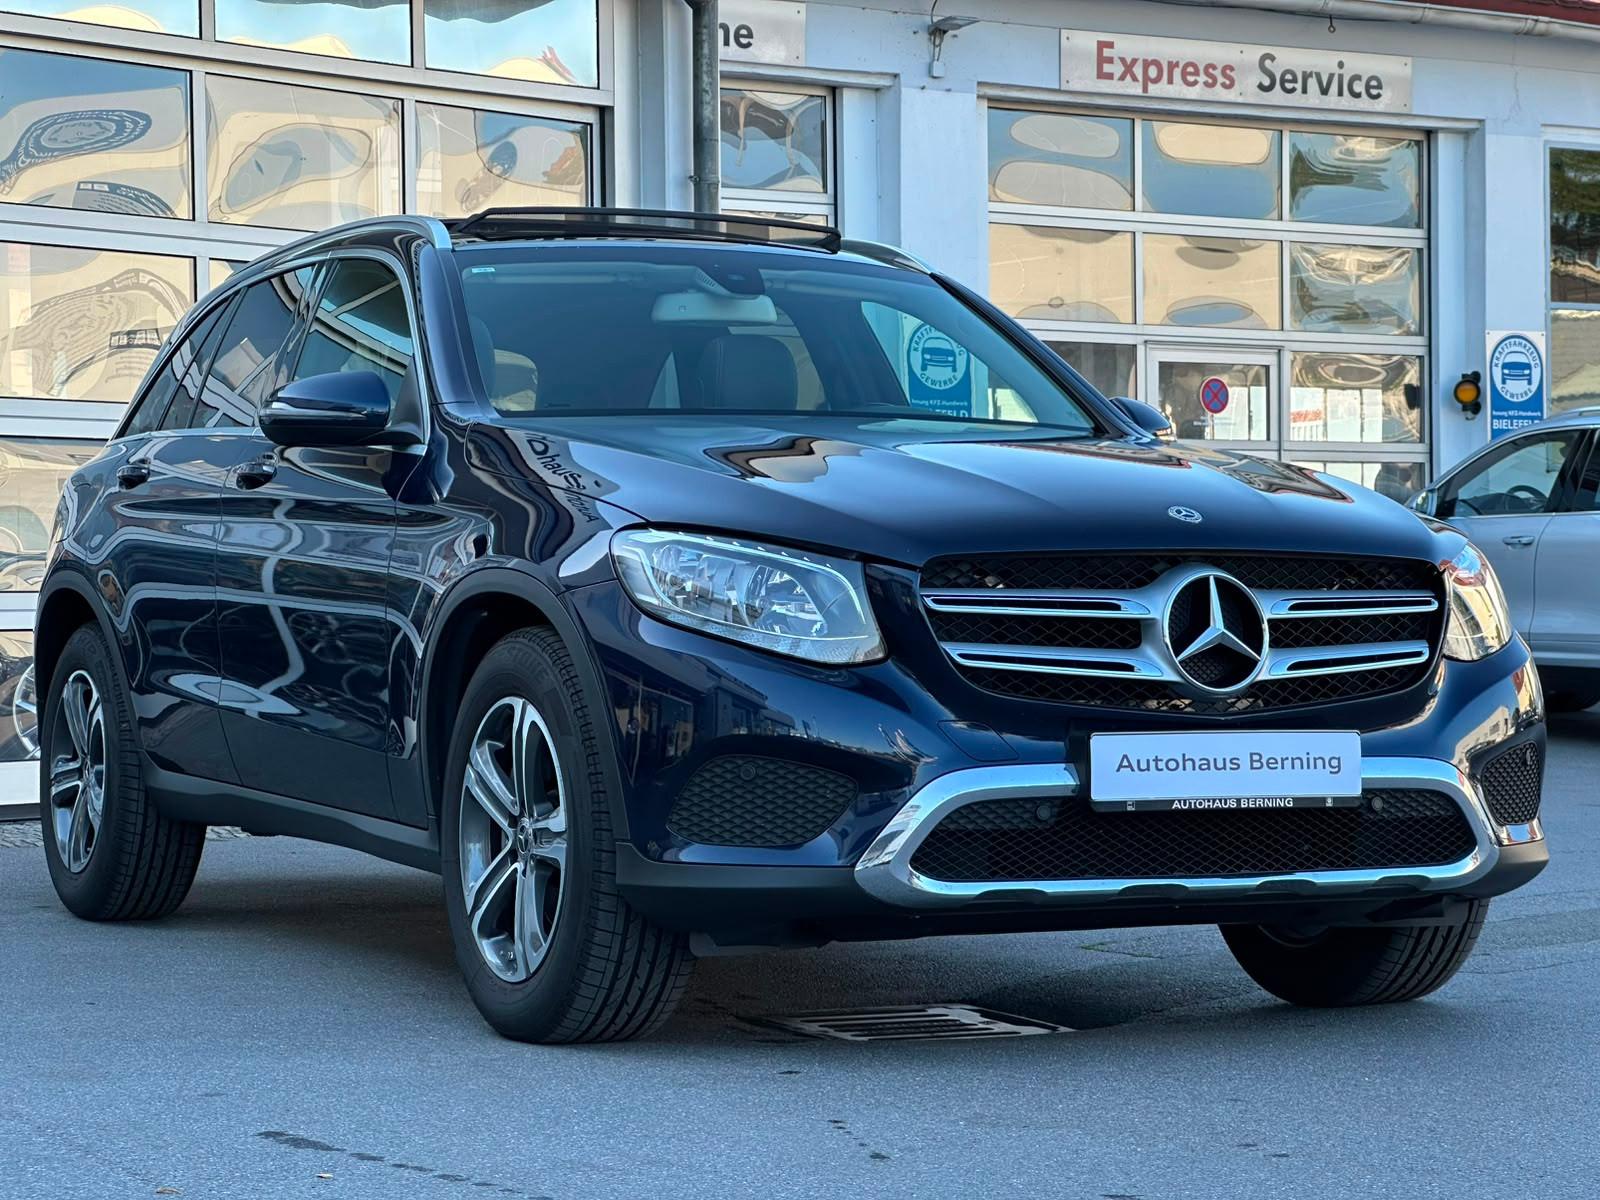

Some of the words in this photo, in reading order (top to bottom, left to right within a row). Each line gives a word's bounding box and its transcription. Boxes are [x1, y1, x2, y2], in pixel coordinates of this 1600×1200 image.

[1096, 40, 1236, 93] Express
[1257, 53, 1383, 100] Service
[1494, 340, 1540, 369] KRAFTFAHRZEUG
[920, 372, 958, 388] GEWERBE
[1500, 386, 1533, 400] GEWERBE
[1116, 754, 1241, 773] Autohaus
[1249, 752, 1342, 774] Berning
[1172, 799, 1237, 809] AUTOHAUS
[1240, 797, 1294, 808] BERNING
